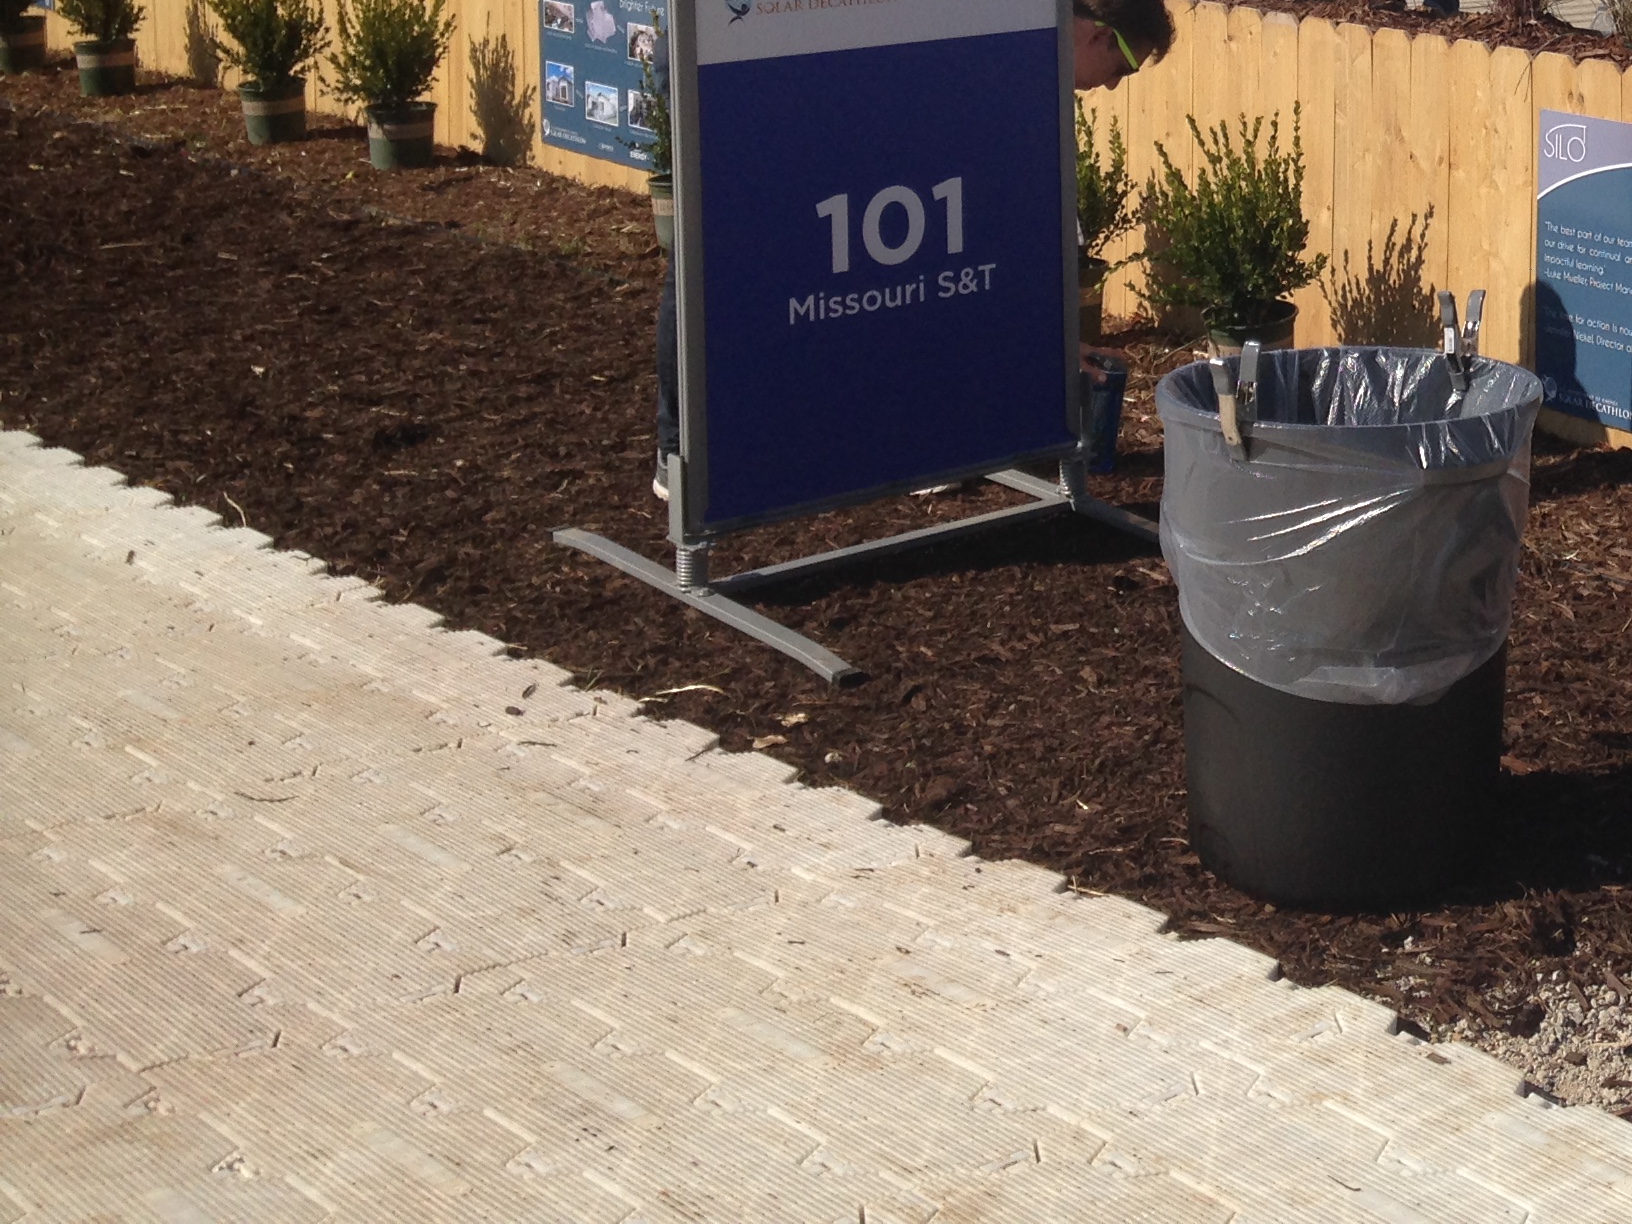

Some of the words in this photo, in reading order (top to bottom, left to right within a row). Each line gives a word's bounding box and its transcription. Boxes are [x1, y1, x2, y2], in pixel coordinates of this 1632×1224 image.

[1543, 123, 1587, 163] SILO
[815, 176, 963, 274] 101
[1560, 225, 1576, 236] best
[1577, 230, 1592, 240] part
[1593, 233, 1602, 243] of
[1602, 235, 1615, 245] our
[1544, 239, 1556, 248] our
[1557, 241, 1575, 253] drive
[1588, 249, 1622, 262] continual
[1589, 276, 1614, 291] Project
[789, 274, 925, 326] Missouri
[937, 263, 997, 299] S&T
[1575, 314, 1585, 325] for
[1586, 318, 1610, 331] action
[1596, 335, 1624, 351] Director
